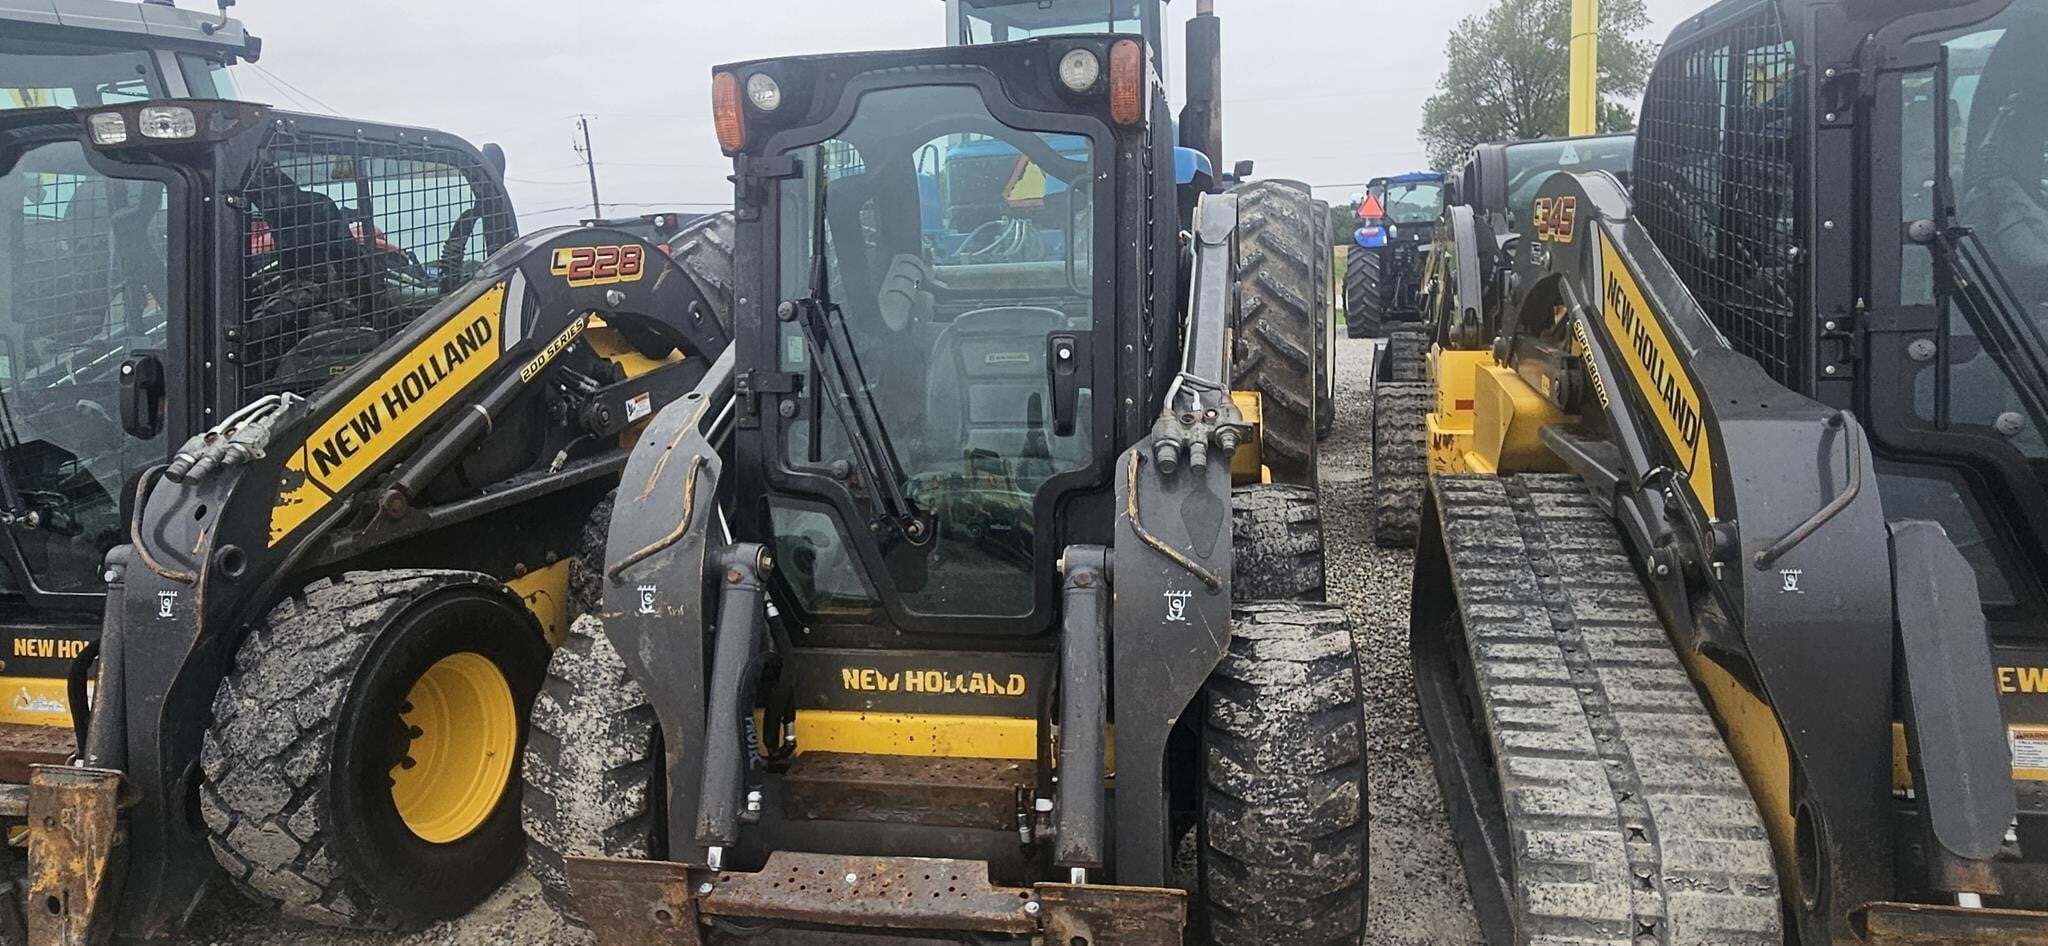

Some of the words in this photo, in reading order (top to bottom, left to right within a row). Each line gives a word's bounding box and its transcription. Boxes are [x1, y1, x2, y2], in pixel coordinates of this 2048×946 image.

[552, 244, 645, 287] L228
[521, 356, 545, 381] 200
[547, 319, 584, 359] SERIES
[1574, 319, 1609, 410] SUPERBOOM
[1606, 271, 1634, 334] NEW
[1632, 322, 1697, 448] HOLLAND
[312, 403, 382, 477] NEW
[381, 316, 492, 421] HOLLAND
[14, 638, 55, 657] NEW
[842, 668, 899, 691] NEW
[1996, 667, 2048, 693] EW
